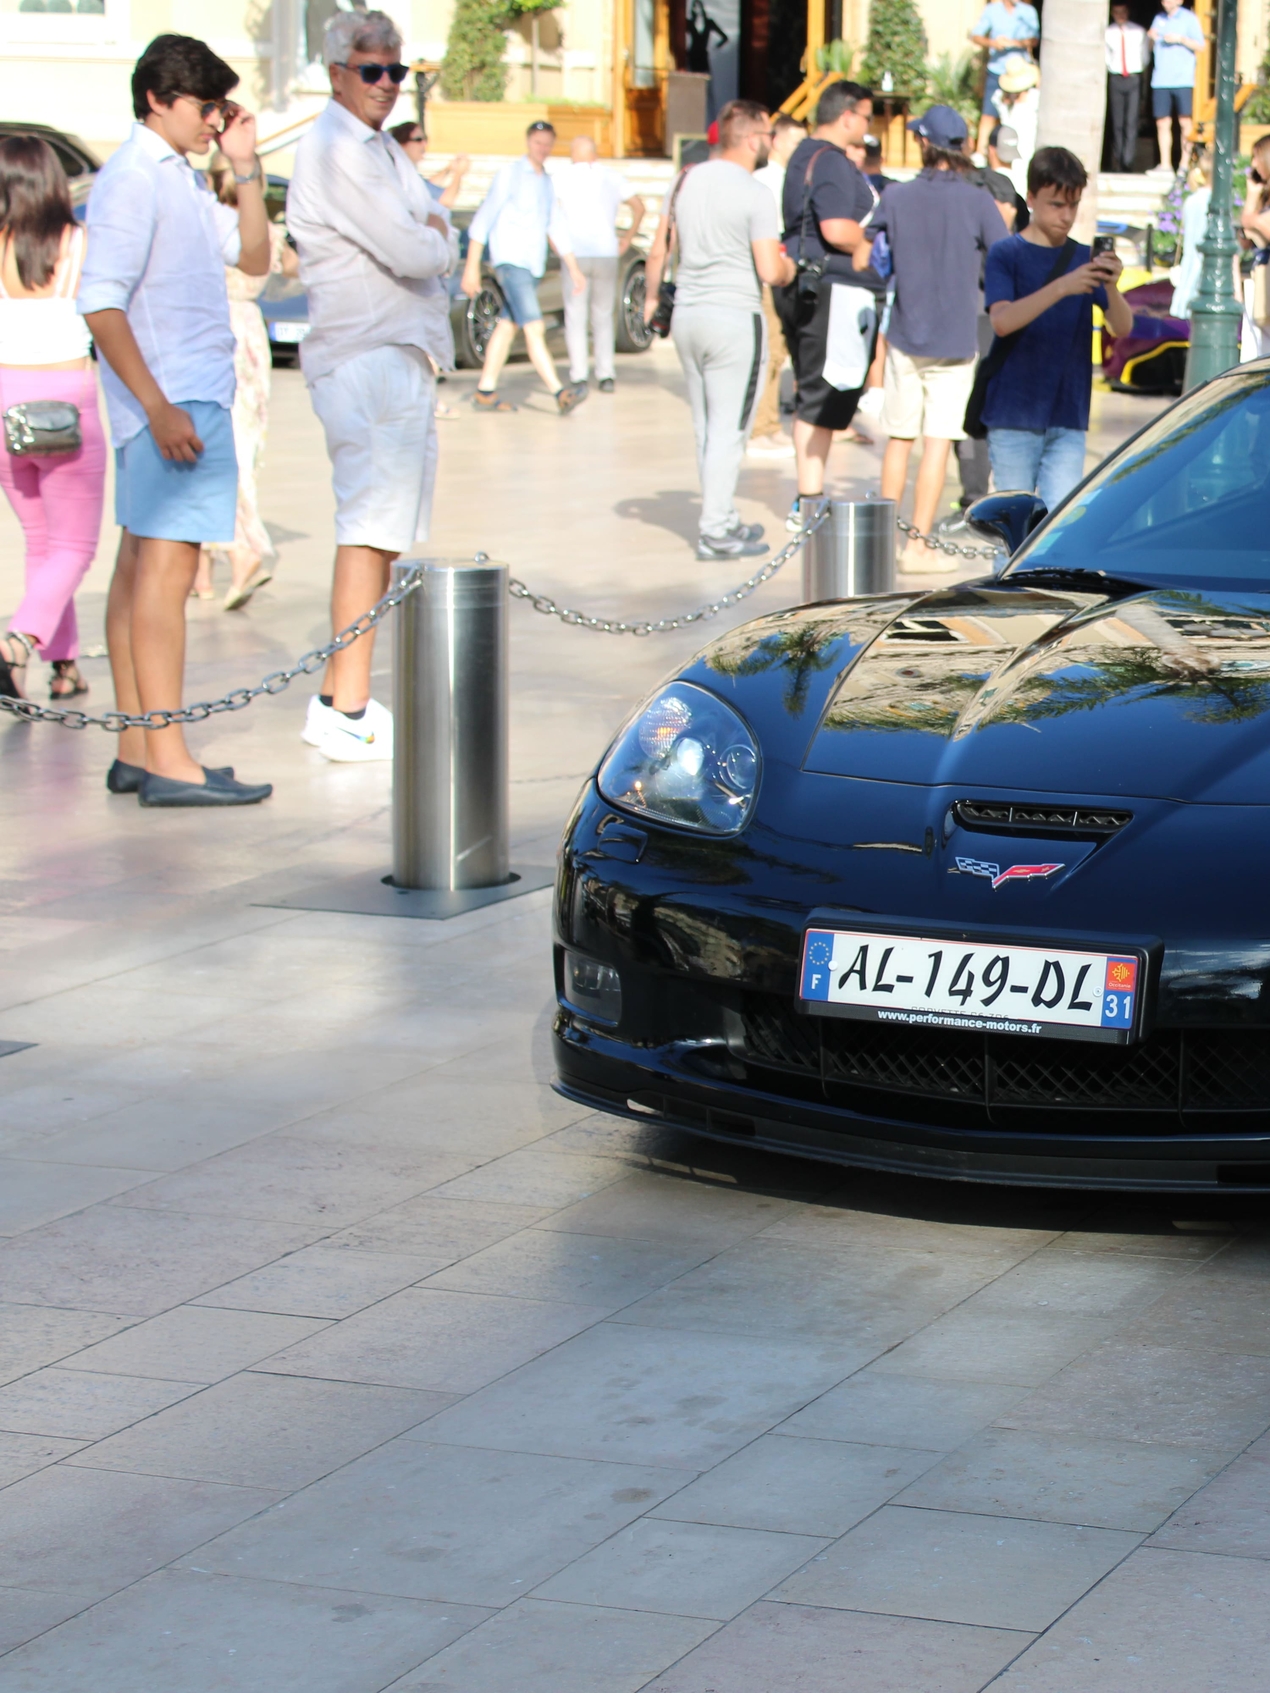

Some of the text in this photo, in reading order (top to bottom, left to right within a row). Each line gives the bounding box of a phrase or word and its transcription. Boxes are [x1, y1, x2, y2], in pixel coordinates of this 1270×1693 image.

[811, 974, 822, 990] F
[838, 943, 1093, 1011] AL-149-DL
[1105, 994, 1131, 1019] 31
[877, 1010, 1043, 1034] www.performance-motors.fr
